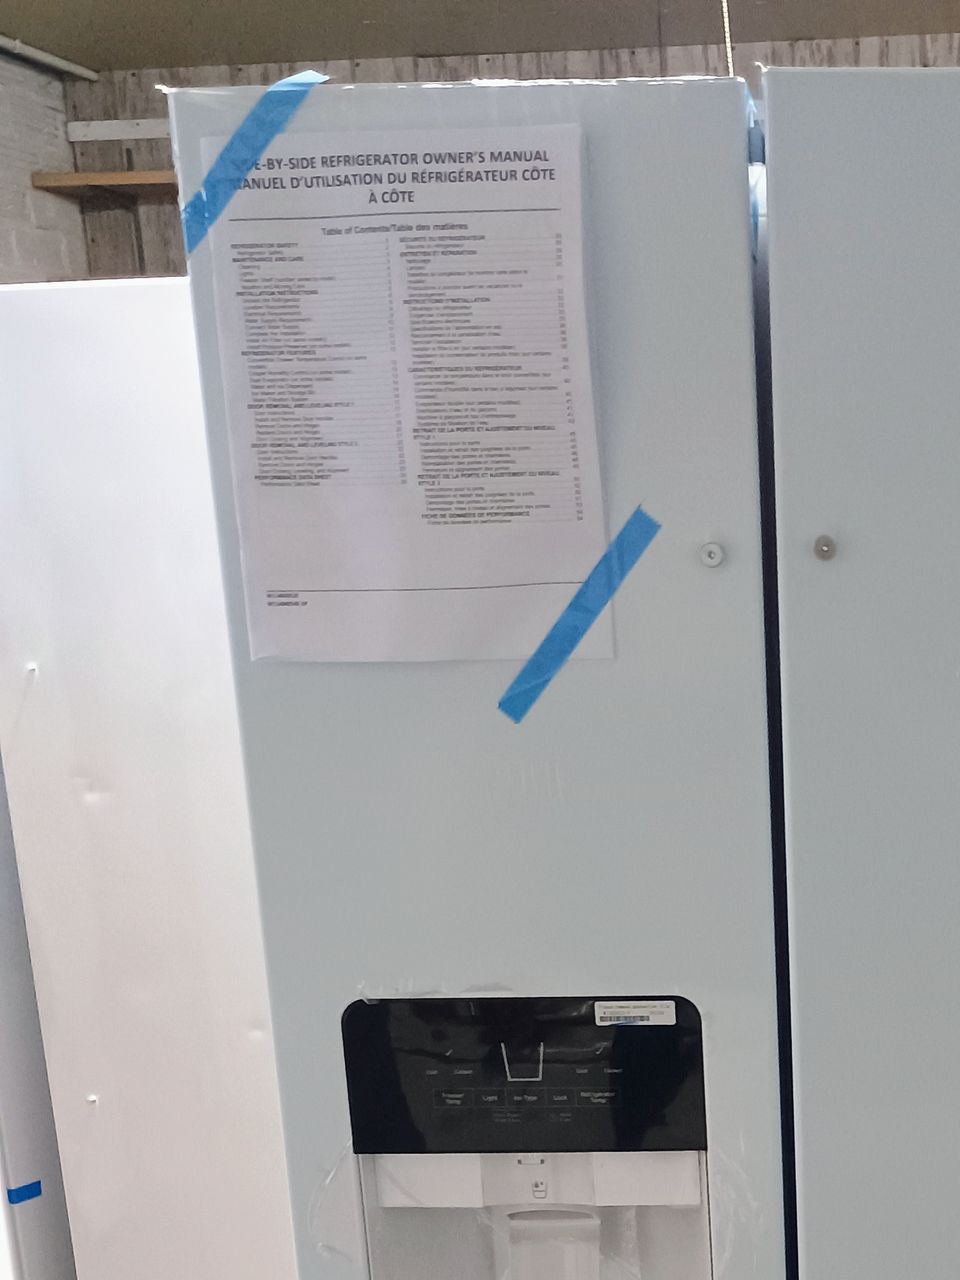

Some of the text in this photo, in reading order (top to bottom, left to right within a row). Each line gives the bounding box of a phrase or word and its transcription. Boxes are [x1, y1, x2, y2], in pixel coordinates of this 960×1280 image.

[233, 156, 316, 171] E-BY-SIDE
[321, 153, 418, 168] REFRIGERATOR
[489, 150, 550, 163] MANUAL
[388, 172, 406, 185] DU
[411, 168, 518, 183] RÉFRIGÉRATEUR
[522, 166, 556, 182] CÔTE
[368, 188, 415, 203] À CÔTE
[321, 227, 343, 236] Table
